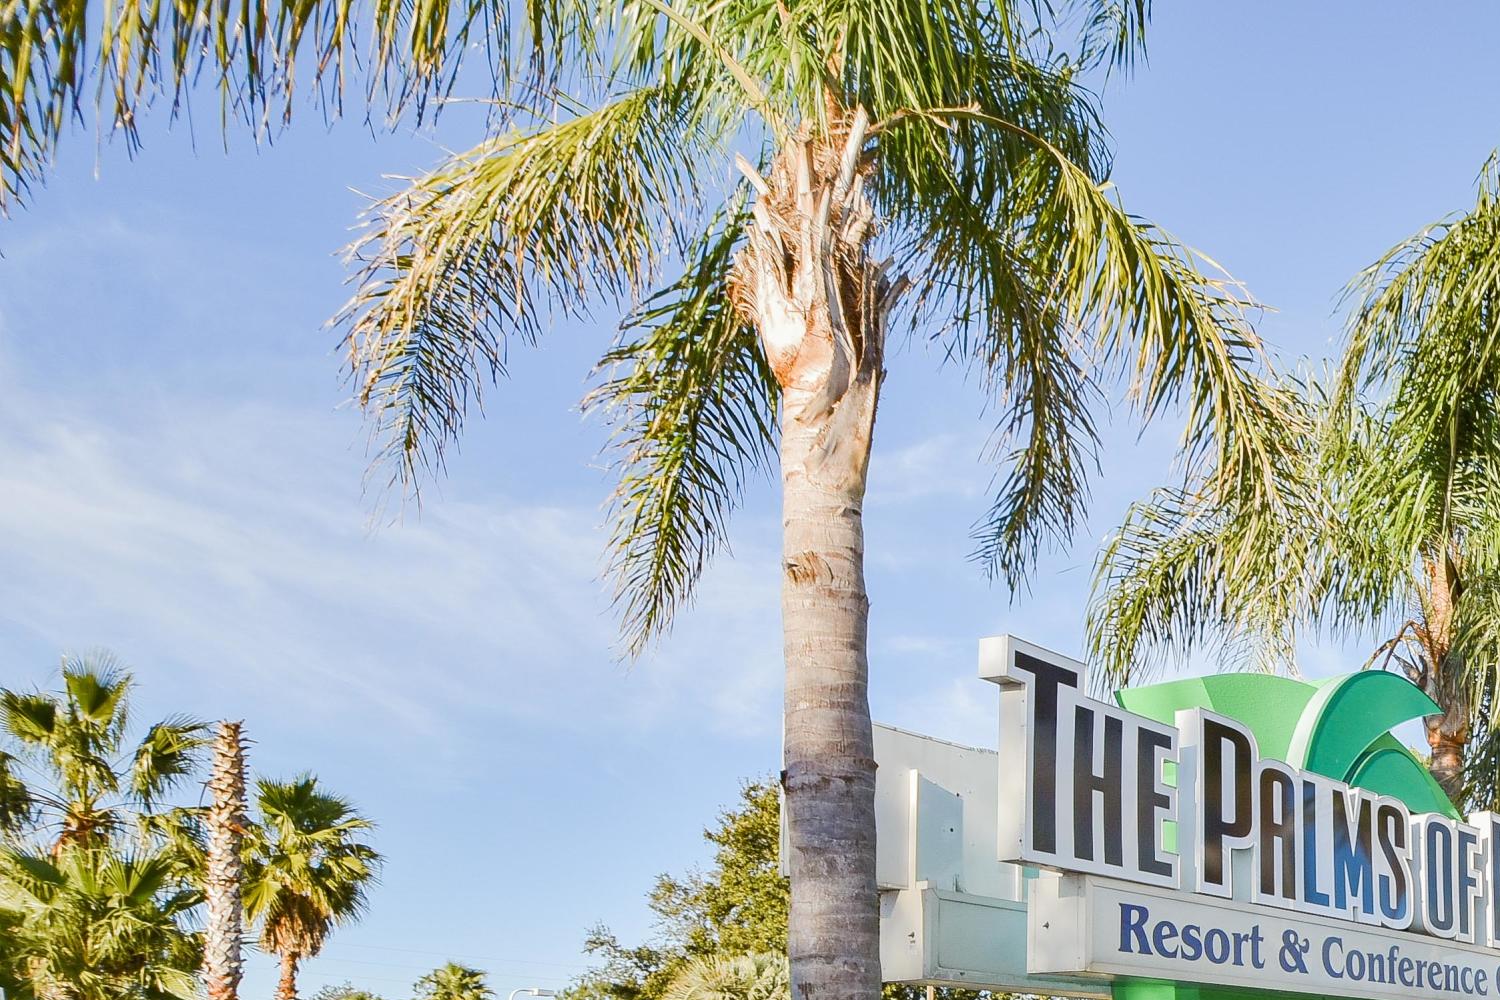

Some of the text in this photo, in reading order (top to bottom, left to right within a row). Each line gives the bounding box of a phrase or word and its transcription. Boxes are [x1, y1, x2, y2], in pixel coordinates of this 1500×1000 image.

[1014, 649, 1174, 878] THE
[1203, 718, 1407, 921] PALMS
[1426, 821, 1477, 935] OF
[1118, 902, 1266, 969] Resort
[1278, 929, 1310, 975] &
[1321, 935, 1488, 996] Conference
